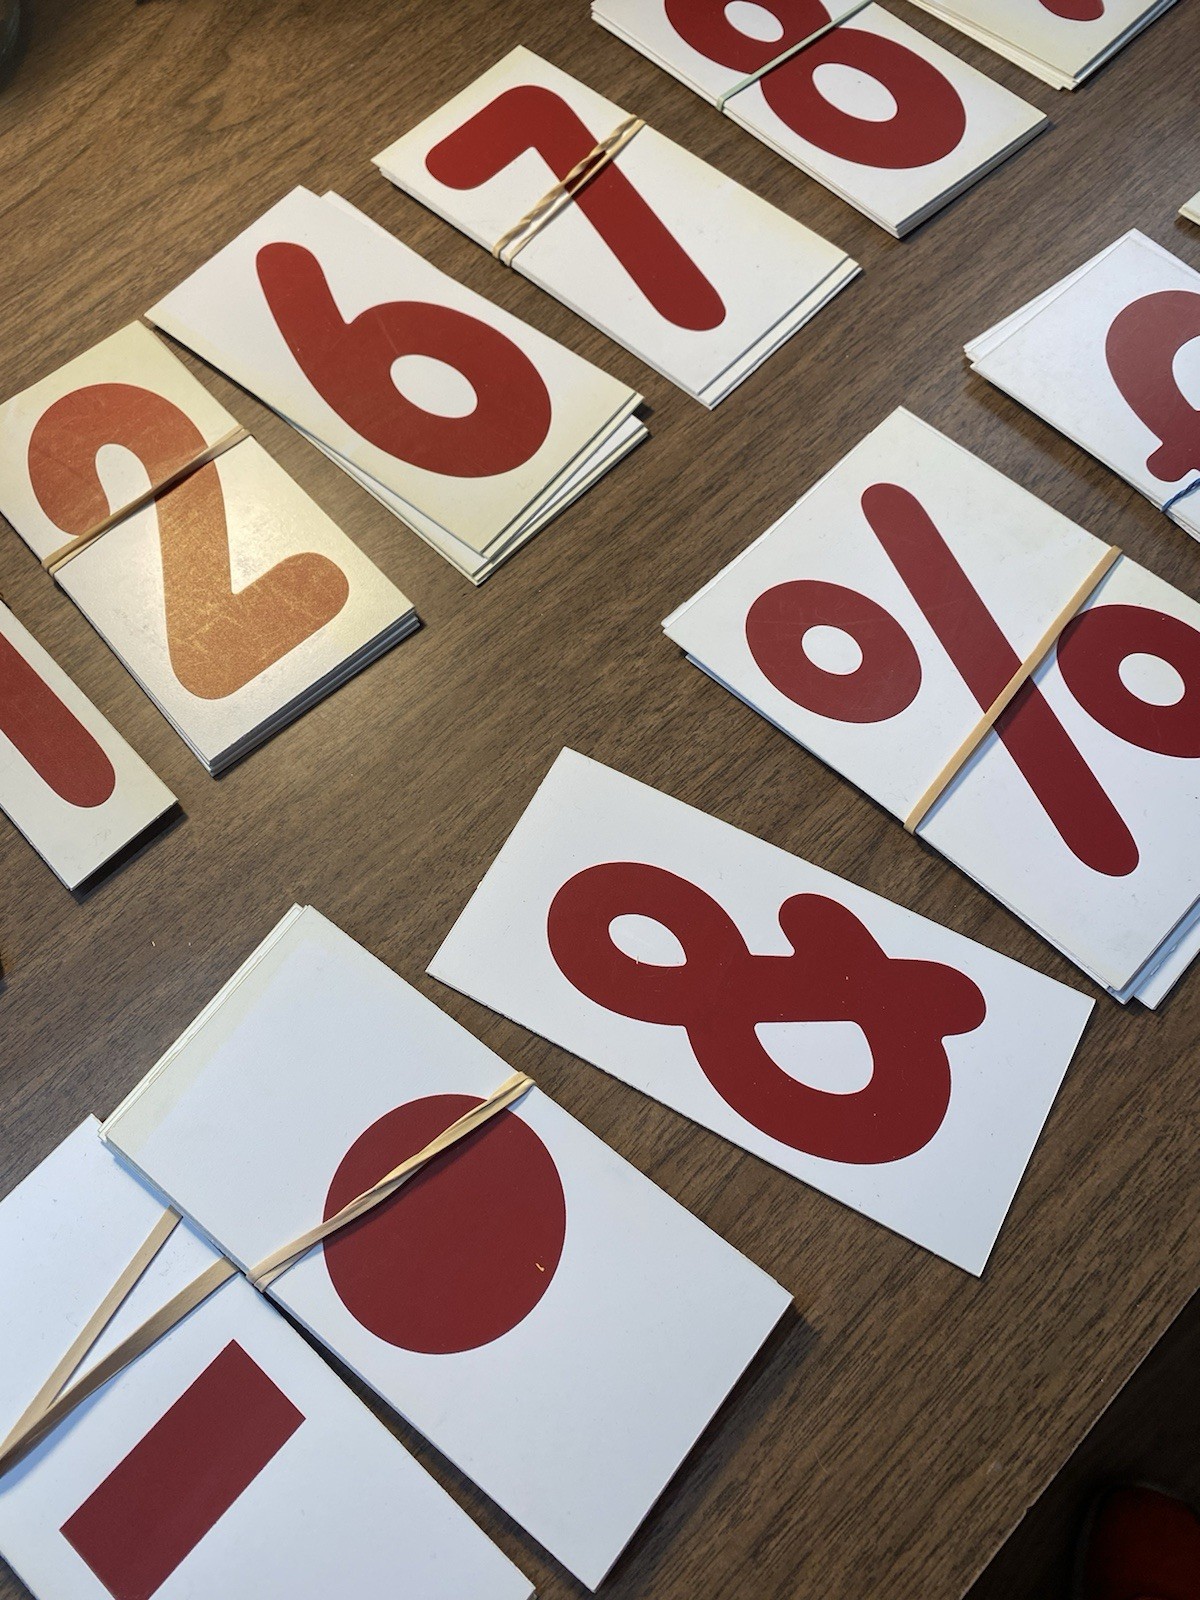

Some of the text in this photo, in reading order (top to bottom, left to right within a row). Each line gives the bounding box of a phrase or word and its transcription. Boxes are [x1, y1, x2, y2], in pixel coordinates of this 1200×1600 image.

[424, 84, 727, 331] 7
[664, 0, 966, 169] 8
[255, 241, 552, 478] 6
[28, 382, 349, 700] 2
[746, 483, 1200, 876] %
[548, 862, 986, 1164] &
